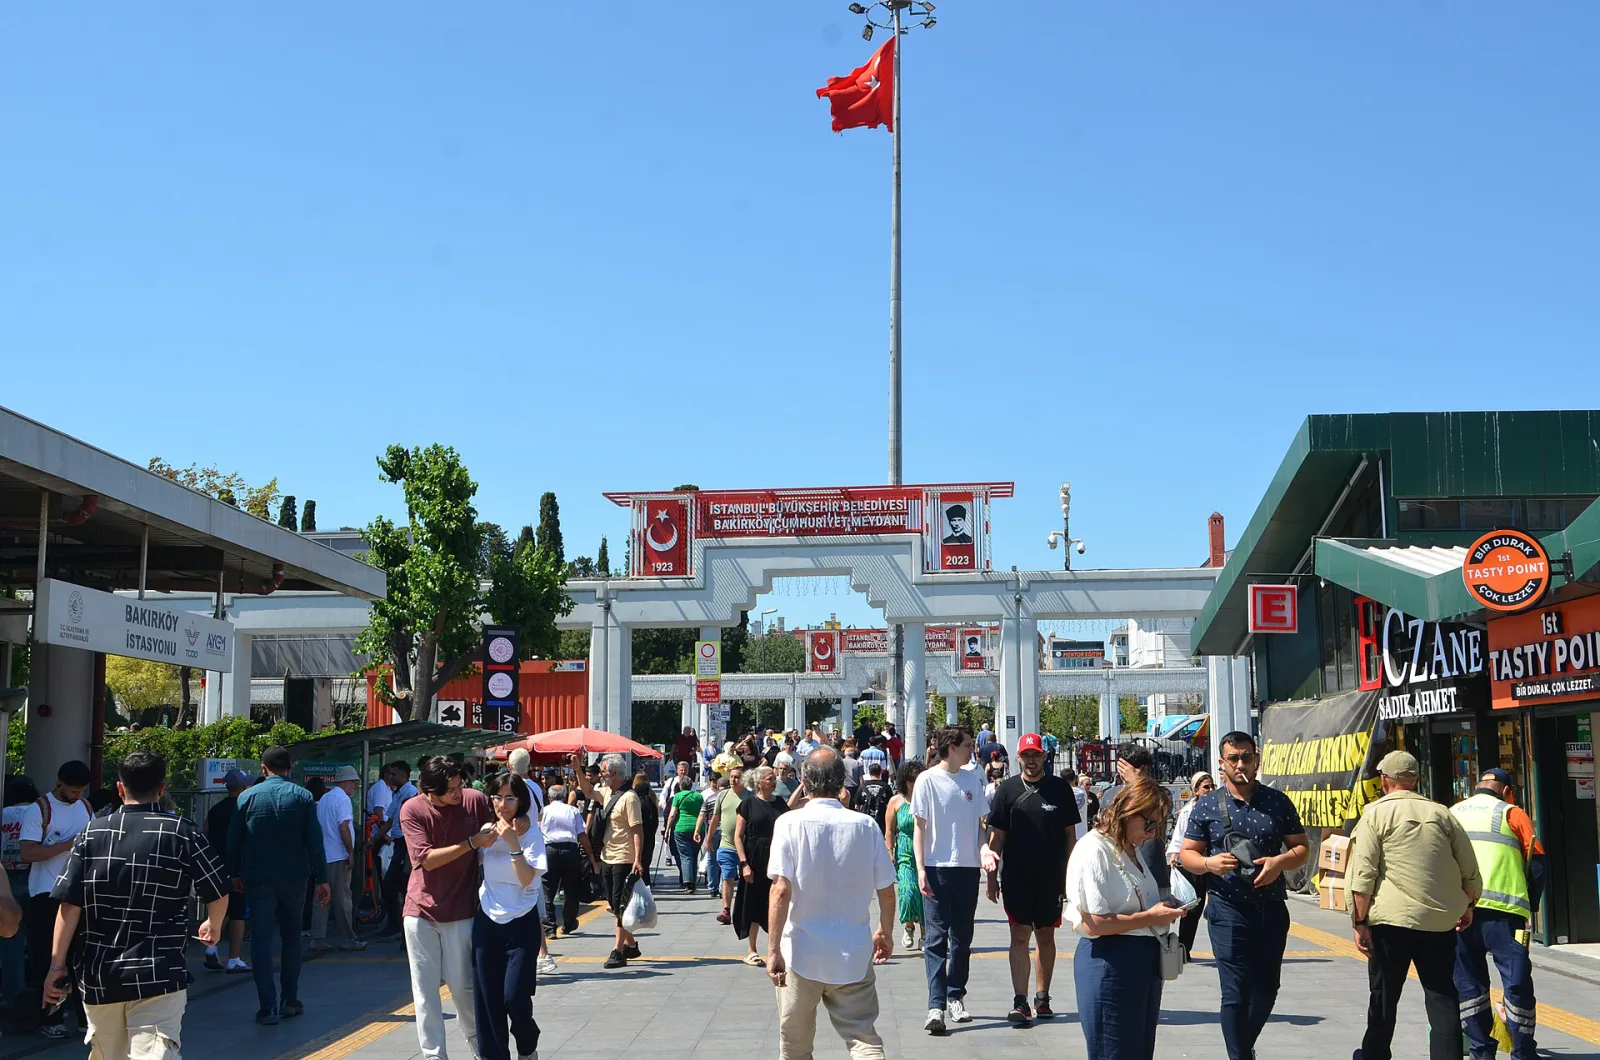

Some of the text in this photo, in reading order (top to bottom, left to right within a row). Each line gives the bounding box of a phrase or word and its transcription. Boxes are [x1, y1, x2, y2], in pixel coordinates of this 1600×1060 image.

[710, 497, 907, 515] İSTANBUL BÜYÜKŞEHİR BELEDİYESİ
[851, 514, 904, 527] MEYDANI
[1475, 537, 1533, 560] BİR DURAK
[1497, 554, 1510, 562] 1st
[651, 562, 673, 572] 1923
[946, 555, 969, 566] 2023
[1467, 562, 1545, 579] TASTY POINT
[1479, 580, 1536, 603] ÇOK LEZZET
[125, 604, 179, 632] BAKIRKÖY
[1261, 593, 1287, 624] E
[1541, 612, 1558, 635] 1st
[126, 629, 177, 656] İSTASYONU
[1353, 596, 1483, 692] ECZANE
[1489, 641, 1548, 681] TASTY
[1527, 682, 1551, 695] DURAK,
[1551, 681, 1566, 695] ÇOK
[1566, 678, 1594, 692] LEZZET.
[1379, 687, 1457, 720] SADIK AHMET
